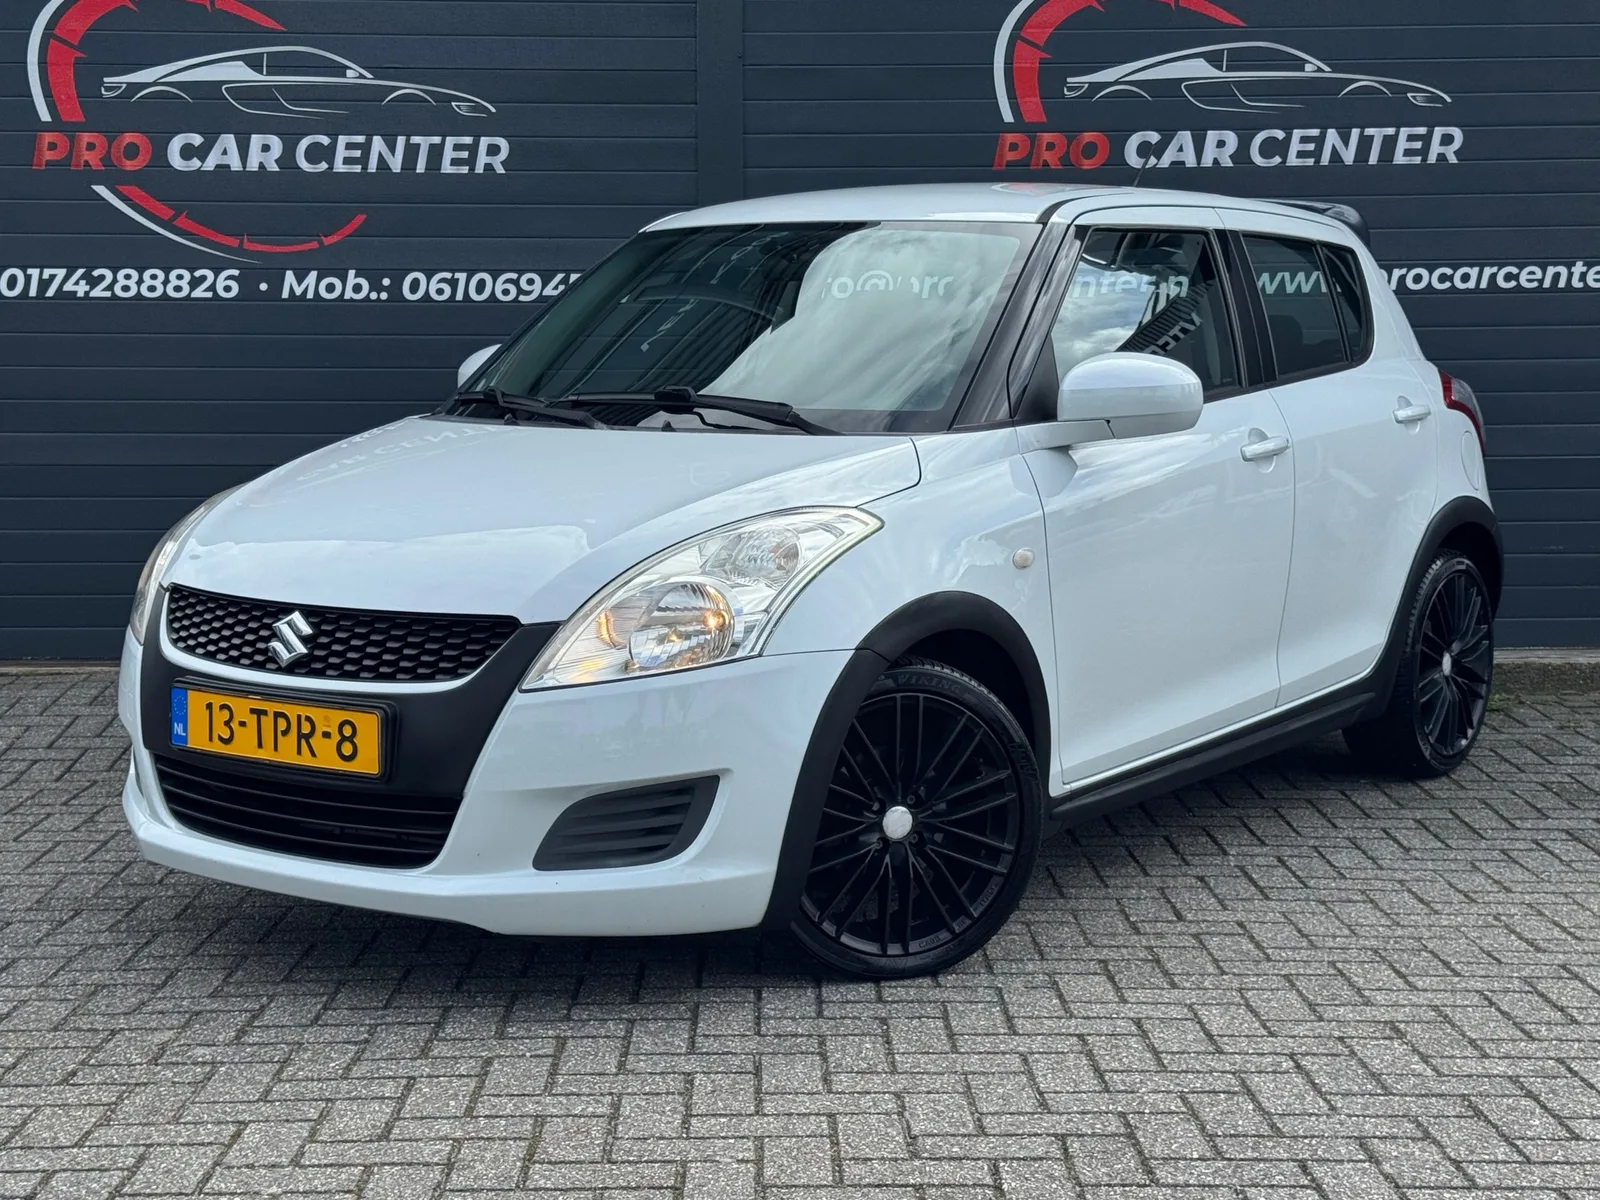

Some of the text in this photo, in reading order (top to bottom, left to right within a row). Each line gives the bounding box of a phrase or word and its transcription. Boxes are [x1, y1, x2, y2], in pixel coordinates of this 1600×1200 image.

[33, 131, 510, 174] PRO CAR CENTER
[994, 126, 1464, 170] PRO CAR CENTER
[0, 267, 240, 299] 0174288826
[281, 269, 390, 300] Mob.:
[1381, 261, 1600, 291] rocarcente
[173, 721, 187, 736] NL
[204, 700, 359, 763] 13-TPR-8
